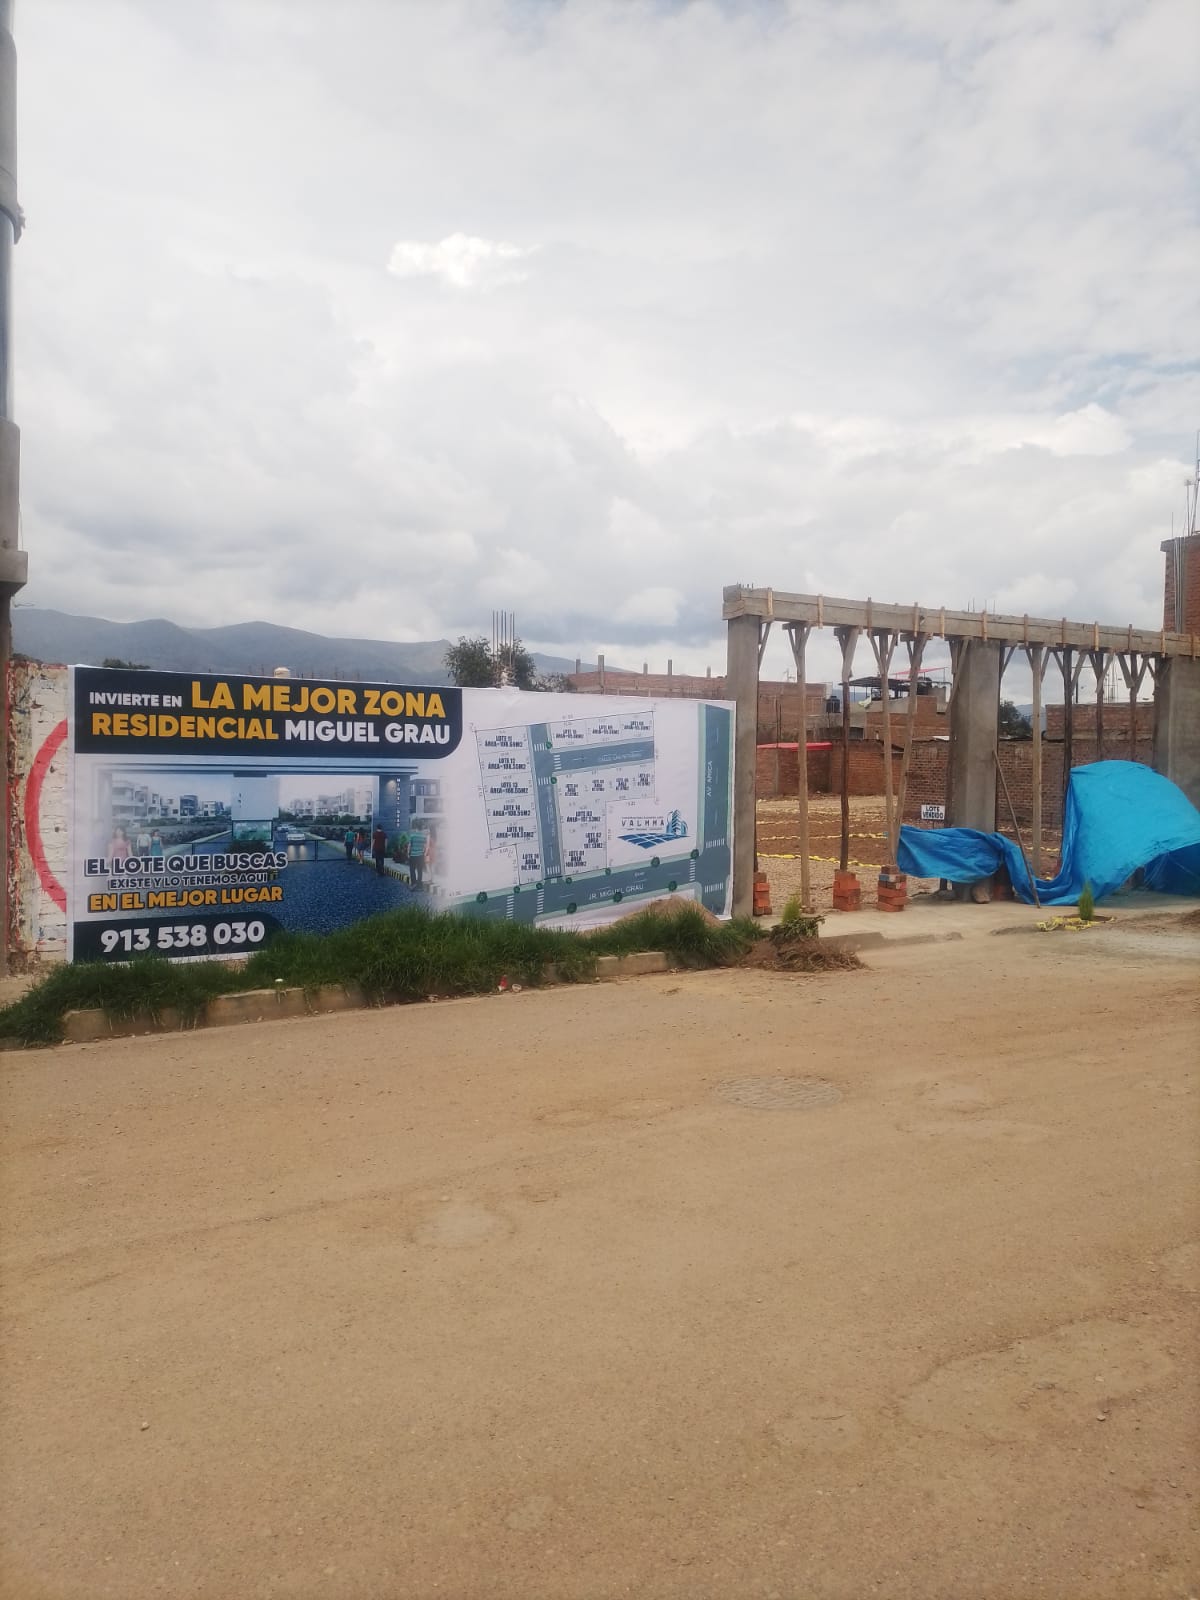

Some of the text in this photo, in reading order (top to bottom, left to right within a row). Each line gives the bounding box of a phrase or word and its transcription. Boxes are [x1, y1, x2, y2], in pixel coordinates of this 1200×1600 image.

[89, 681, 446, 718] INVIERTE EN LA MEJOR ZONA
[91, 712, 450, 745] RESIDENCIAL MIGUEL GRAU
[86, 852, 288, 876] EL LOTE QUE BUSCAS
[109, 878, 151, 890] EXISTE
[154, 877, 162, 888] Y
[164, 876, 180, 887] LO
[182, 874, 237, 886] TENEMOS
[89, 886, 283, 912] EN EL MEJOR LUGAR
[100, 920, 266, 953] 913 538 030
